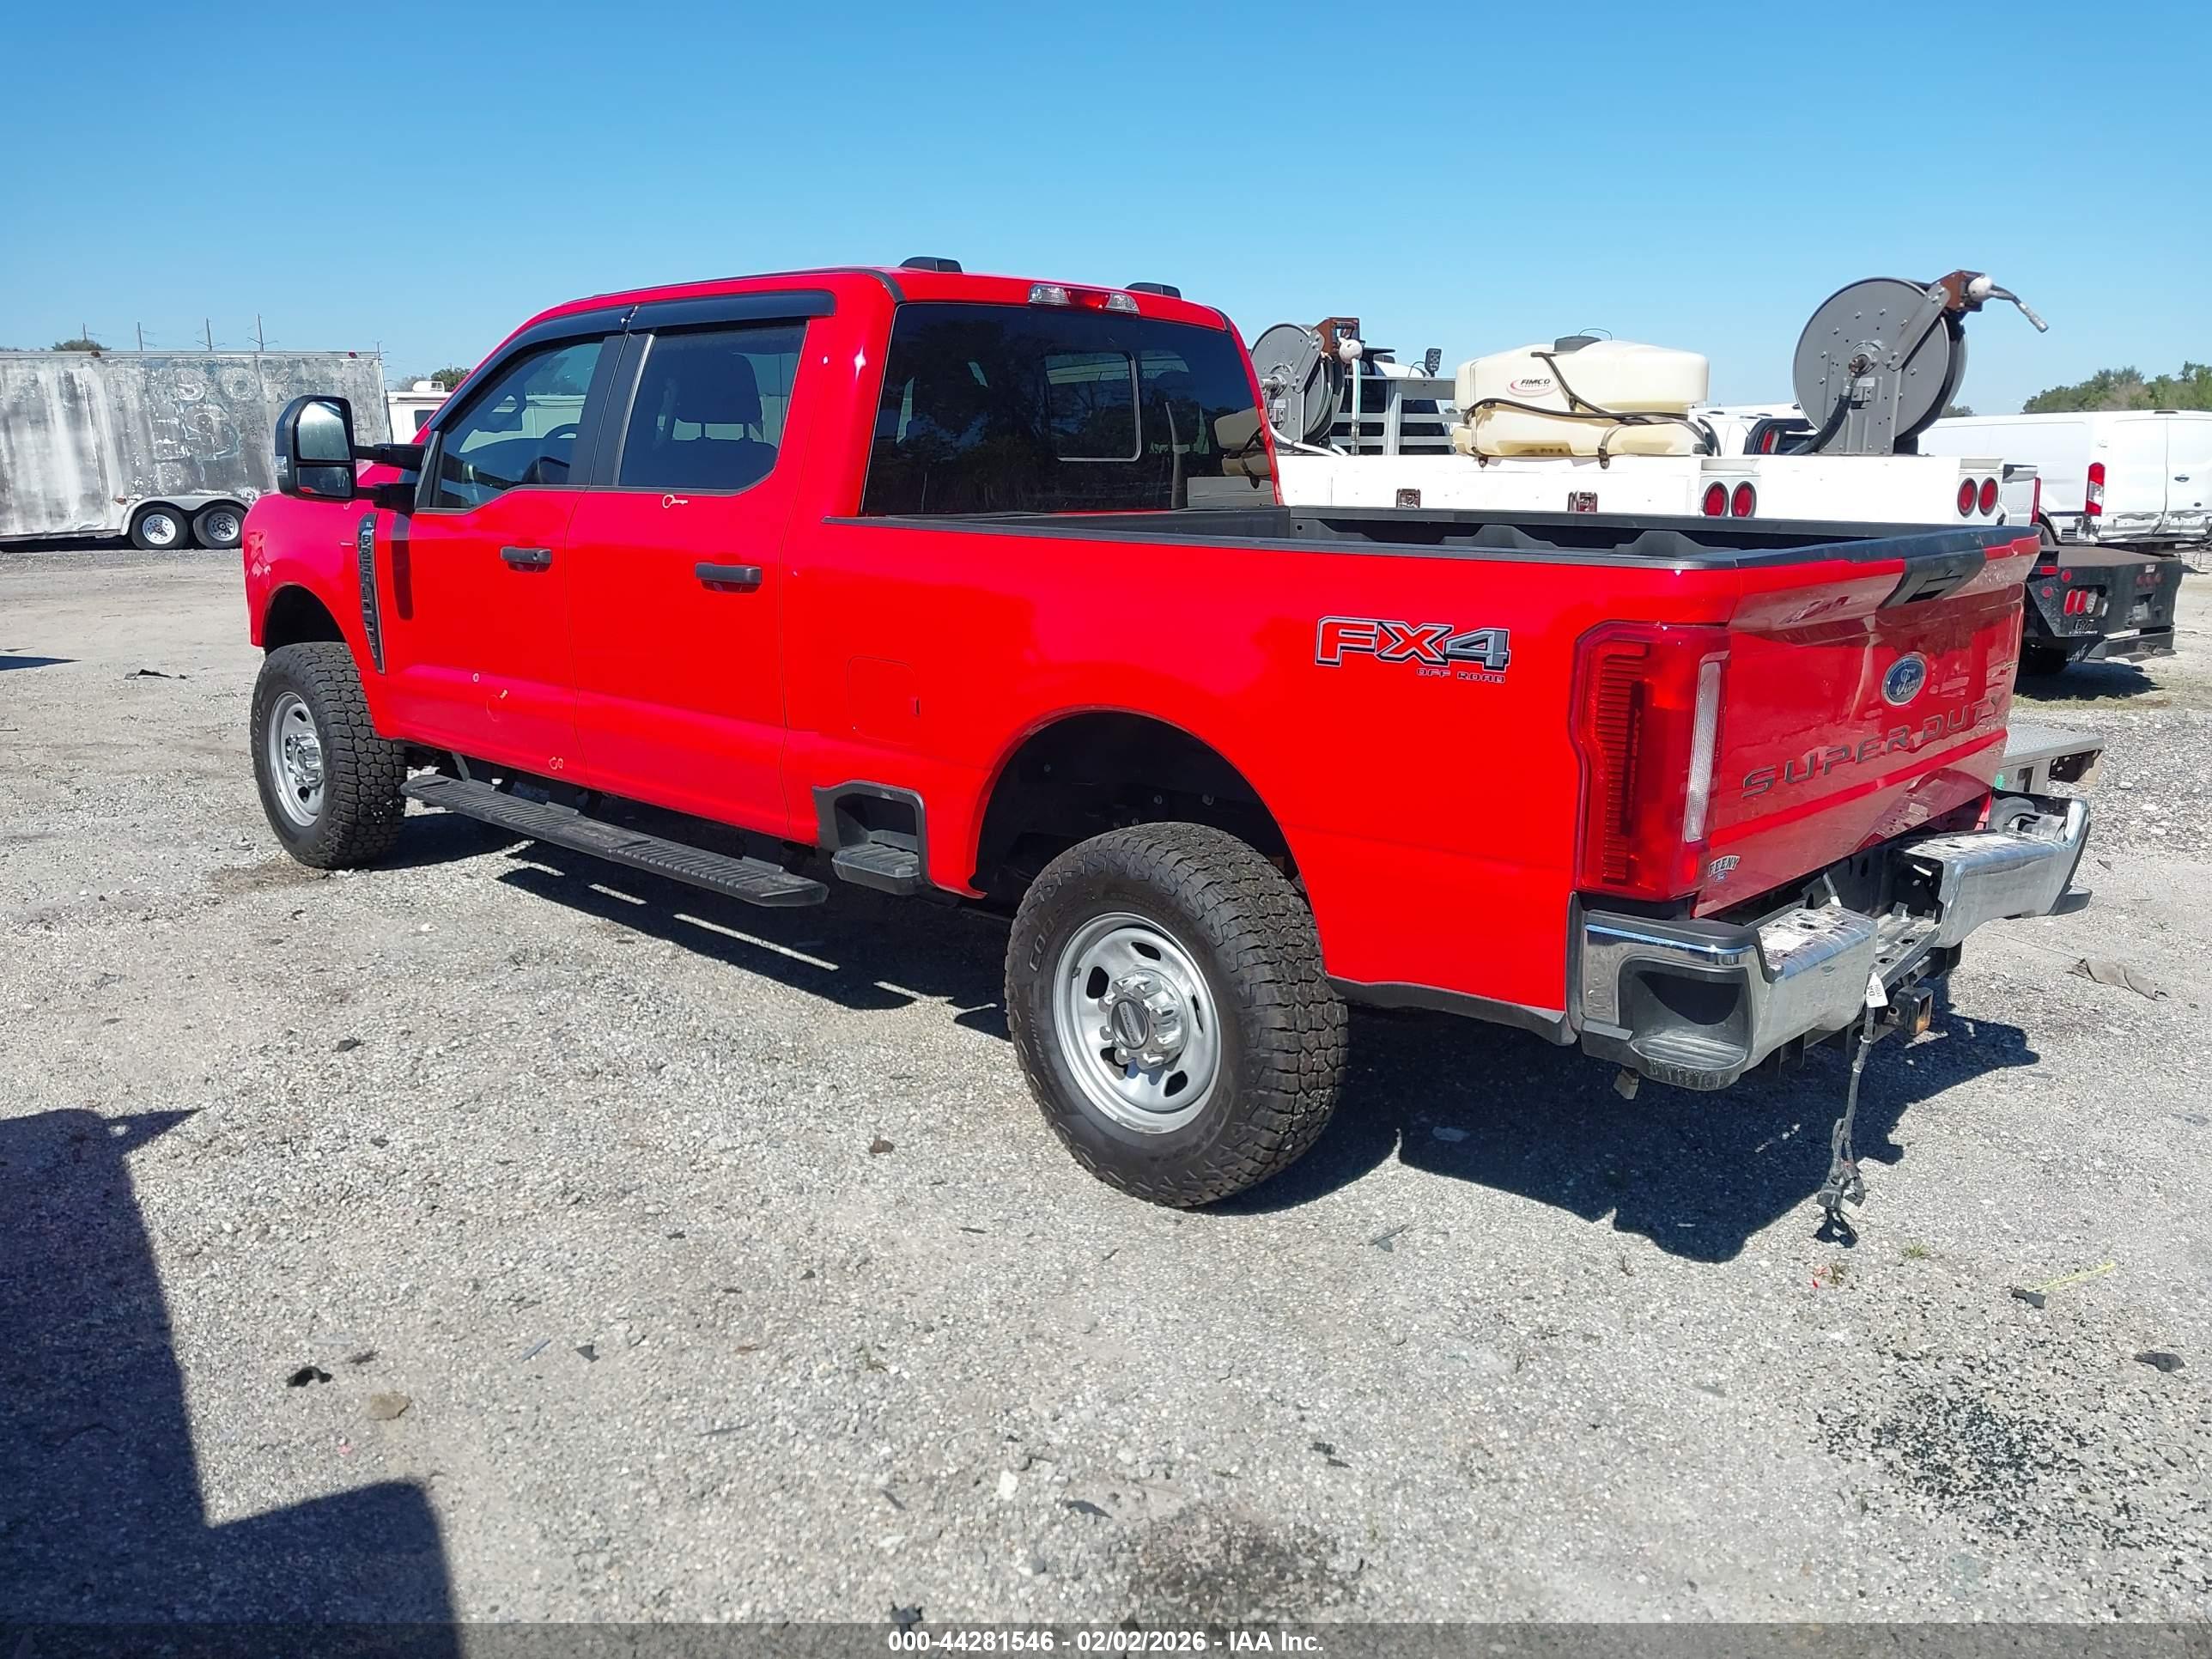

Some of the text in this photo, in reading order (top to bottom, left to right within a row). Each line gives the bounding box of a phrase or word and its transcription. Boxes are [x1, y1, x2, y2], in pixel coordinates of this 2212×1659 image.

[1315, 616, 1511, 672] FX4
[1416, 667, 1506, 684] OFF ROAD
[1741, 694, 2005, 799] SUPER DUTY
[1709, 855, 1740, 877] FEENY
